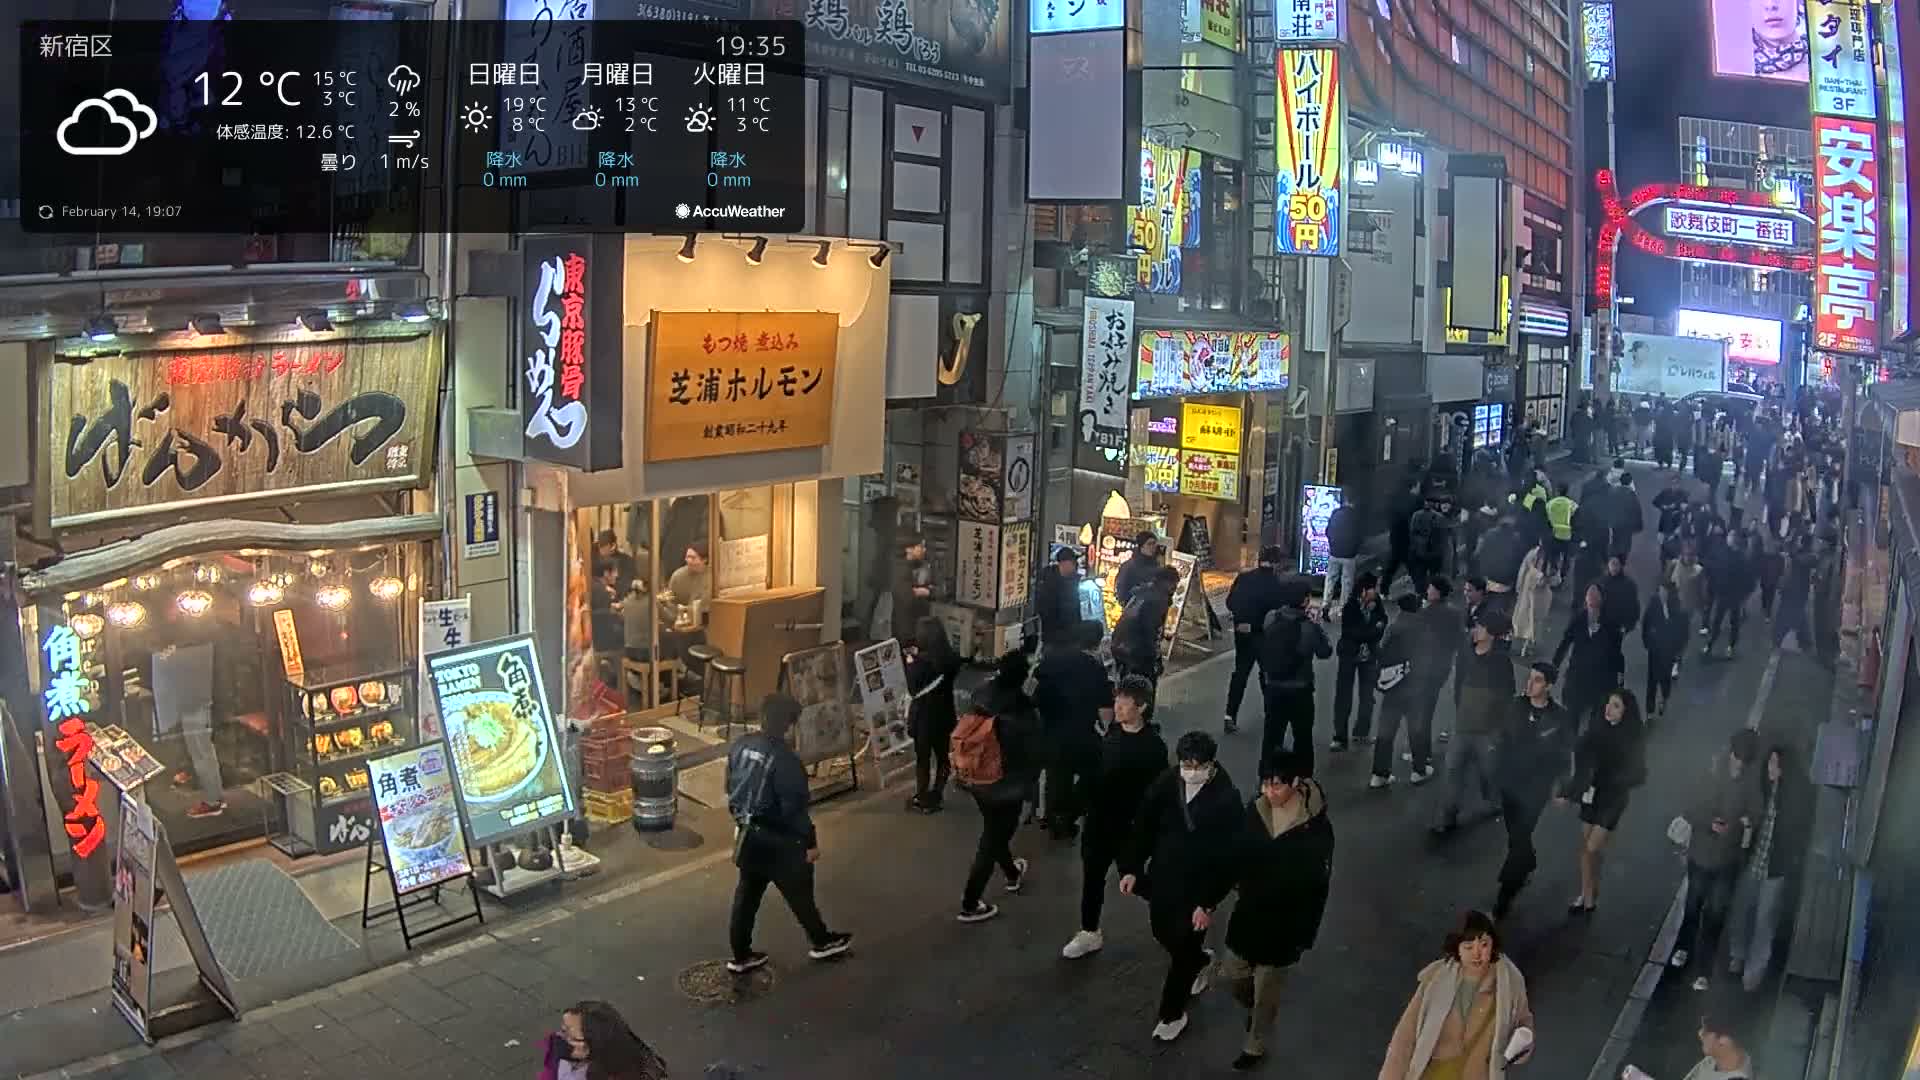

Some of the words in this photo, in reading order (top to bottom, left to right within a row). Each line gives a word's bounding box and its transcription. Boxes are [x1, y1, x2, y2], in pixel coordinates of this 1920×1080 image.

[1818, 0, 1843, 69] タイ
[1849, 0, 1865, 62] 理専門店
[1589, 62, 1610, 78] 7F
[1296, 54, 1322, 190] ハイボール
[1833, 97, 1856, 111] 3F
[1670, 211, 1790, 242] 歌舞伎町一番街
[1818, 125, 1876, 331] 安楽亭
[560, 253, 585, 400] 東京豚骨
[702, 333, 747, 354] もつ焼
[755, 331, 799, 352] 煮込み
[1818, 331, 1837, 347] 2F
[668, 365, 824, 405] 芝浦ホルモン
[1098, 308, 1128, 415] お好み焼き
[65, 377, 408, 492] ばんから
[1100, 432, 1122, 447] B1F
[44, 625, 90, 720] 角煮
[435, 663, 480, 683] TOKYO
[498, 653, 539, 719] 角煮
[55, 717, 105, 858] ラーメン
[377, 765, 421, 798] 角煮
